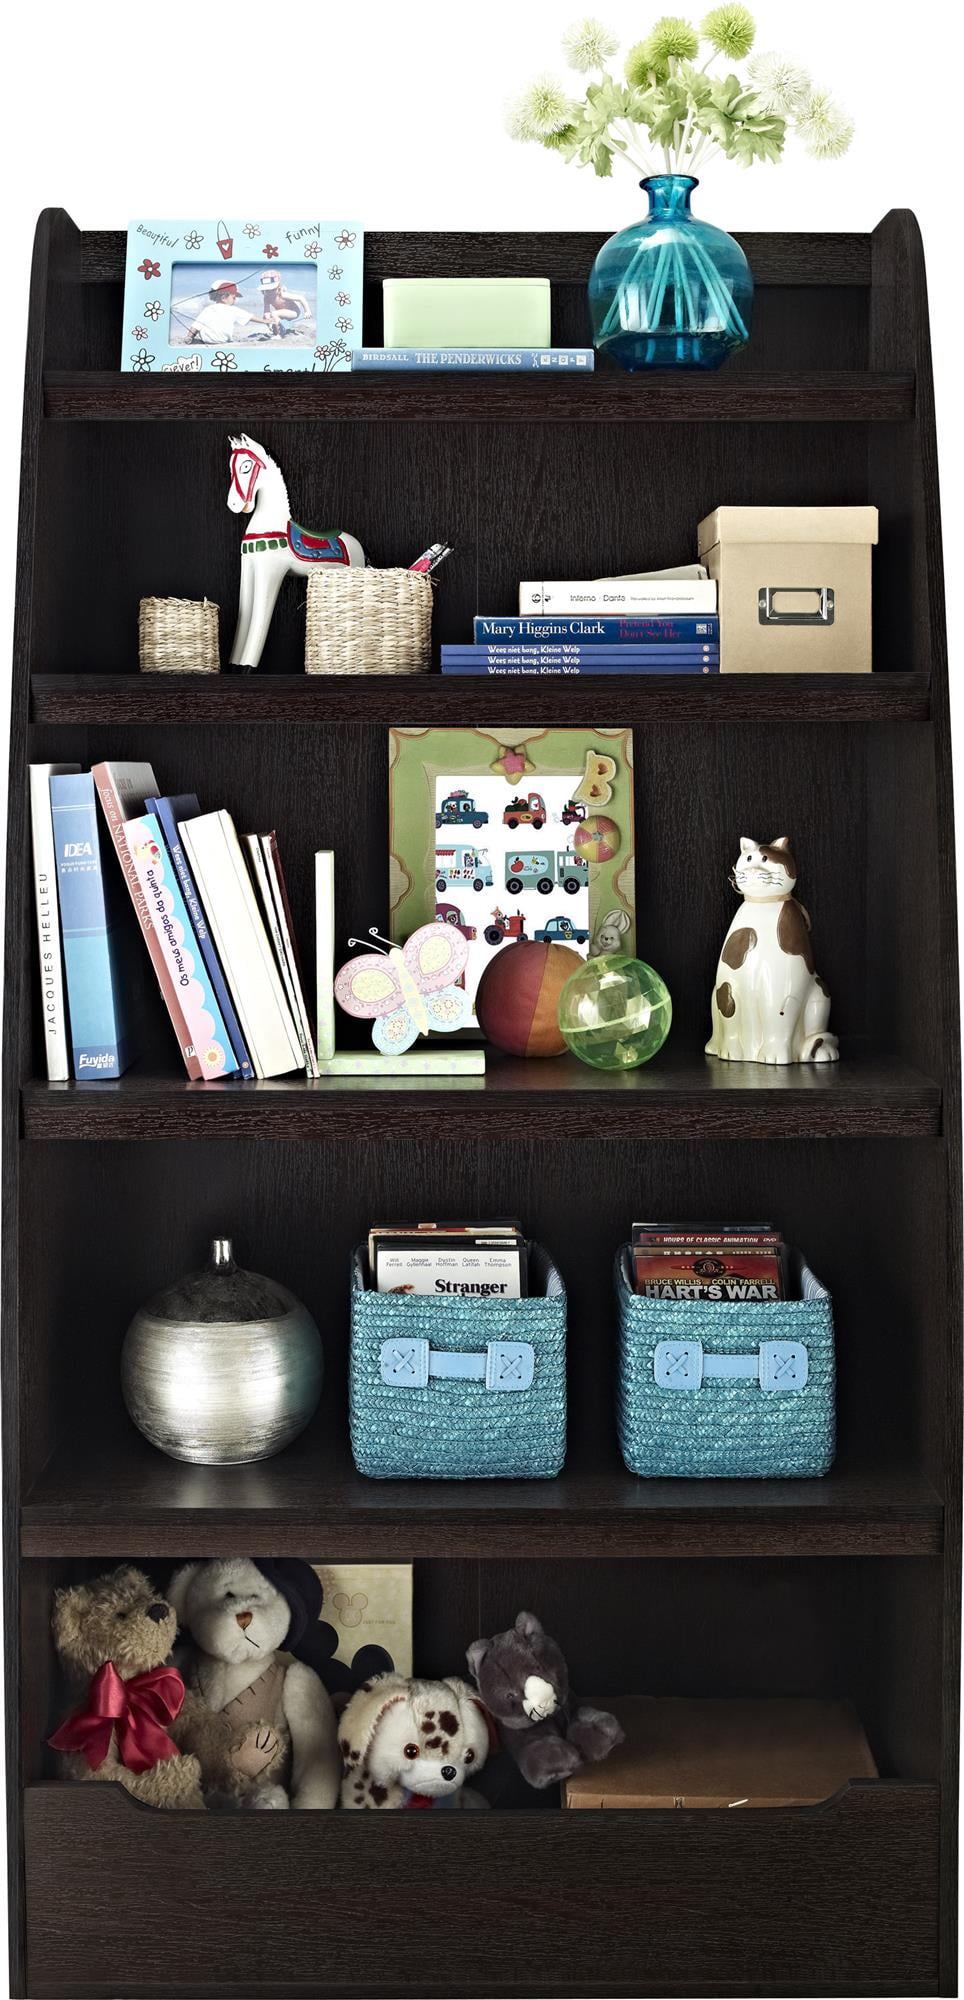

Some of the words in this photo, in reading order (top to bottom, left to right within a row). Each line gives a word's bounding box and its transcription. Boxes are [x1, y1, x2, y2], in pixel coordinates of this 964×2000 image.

[136, 224, 179, 248] Beautiful
[285, 222, 321, 244] funny
[362, 353, 409, 361] BIRDSALL
[415, 352, 439, 364] THE
[440, 352, 522, 365] PENDERWICKS
[570, 594, 596, 602] Inferno
[603, 594, 626, 602] Dante
[482, 622, 516, 638] Mary
[519, 622, 568, 638] Higgins
[569, 621, 606, 634] Clark
[488, 645, 506, 654] Wees
[507, 645, 521, 654] niet
[540, 645, 561, 654] Kleine
[562, 645, 580, 654] Welp
[488, 655, 506, 664] Wees
[507, 655, 521, 664] niet
[540, 655, 561, 664] Kleine
[562, 655, 580, 664] Welp
[488, 666, 506, 674] Wees
[507, 666, 521, 674] niet
[540, 666, 561, 674] Kleine
[562, 666, 580, 674] Welp
[101, 788, 114, 809] focus
[110, 810, 118, 822] on
[64, 842, 93, 858] IDEA
[113, 823, 142, 891] NATIONAL
[146, 869, 163, 899] quinta
[172, 844, 182, 865] Wees
[178, 865, 188, 880] niet
[189, 898, 200, 920] Kleine
[197, 920, 206, 939] Welp
[39, 873, 51, 942] HELLEU
[133, 891, 153, 930] PARKS
[156, 900, 165, 913] da
[161, 914, 178, 947] amigos
[172, 948, 185, 973] meus
[180, 973, 190, 987] Os
[44, 952, 57, 1035] JACQUES
[79, 1053, 115, 1068] Fuyida
[435, 1278, 508, 1297] Stranger
[645, 1285, 722, 1300] HART'S
[725, 1285, 778, 1299] WAR
